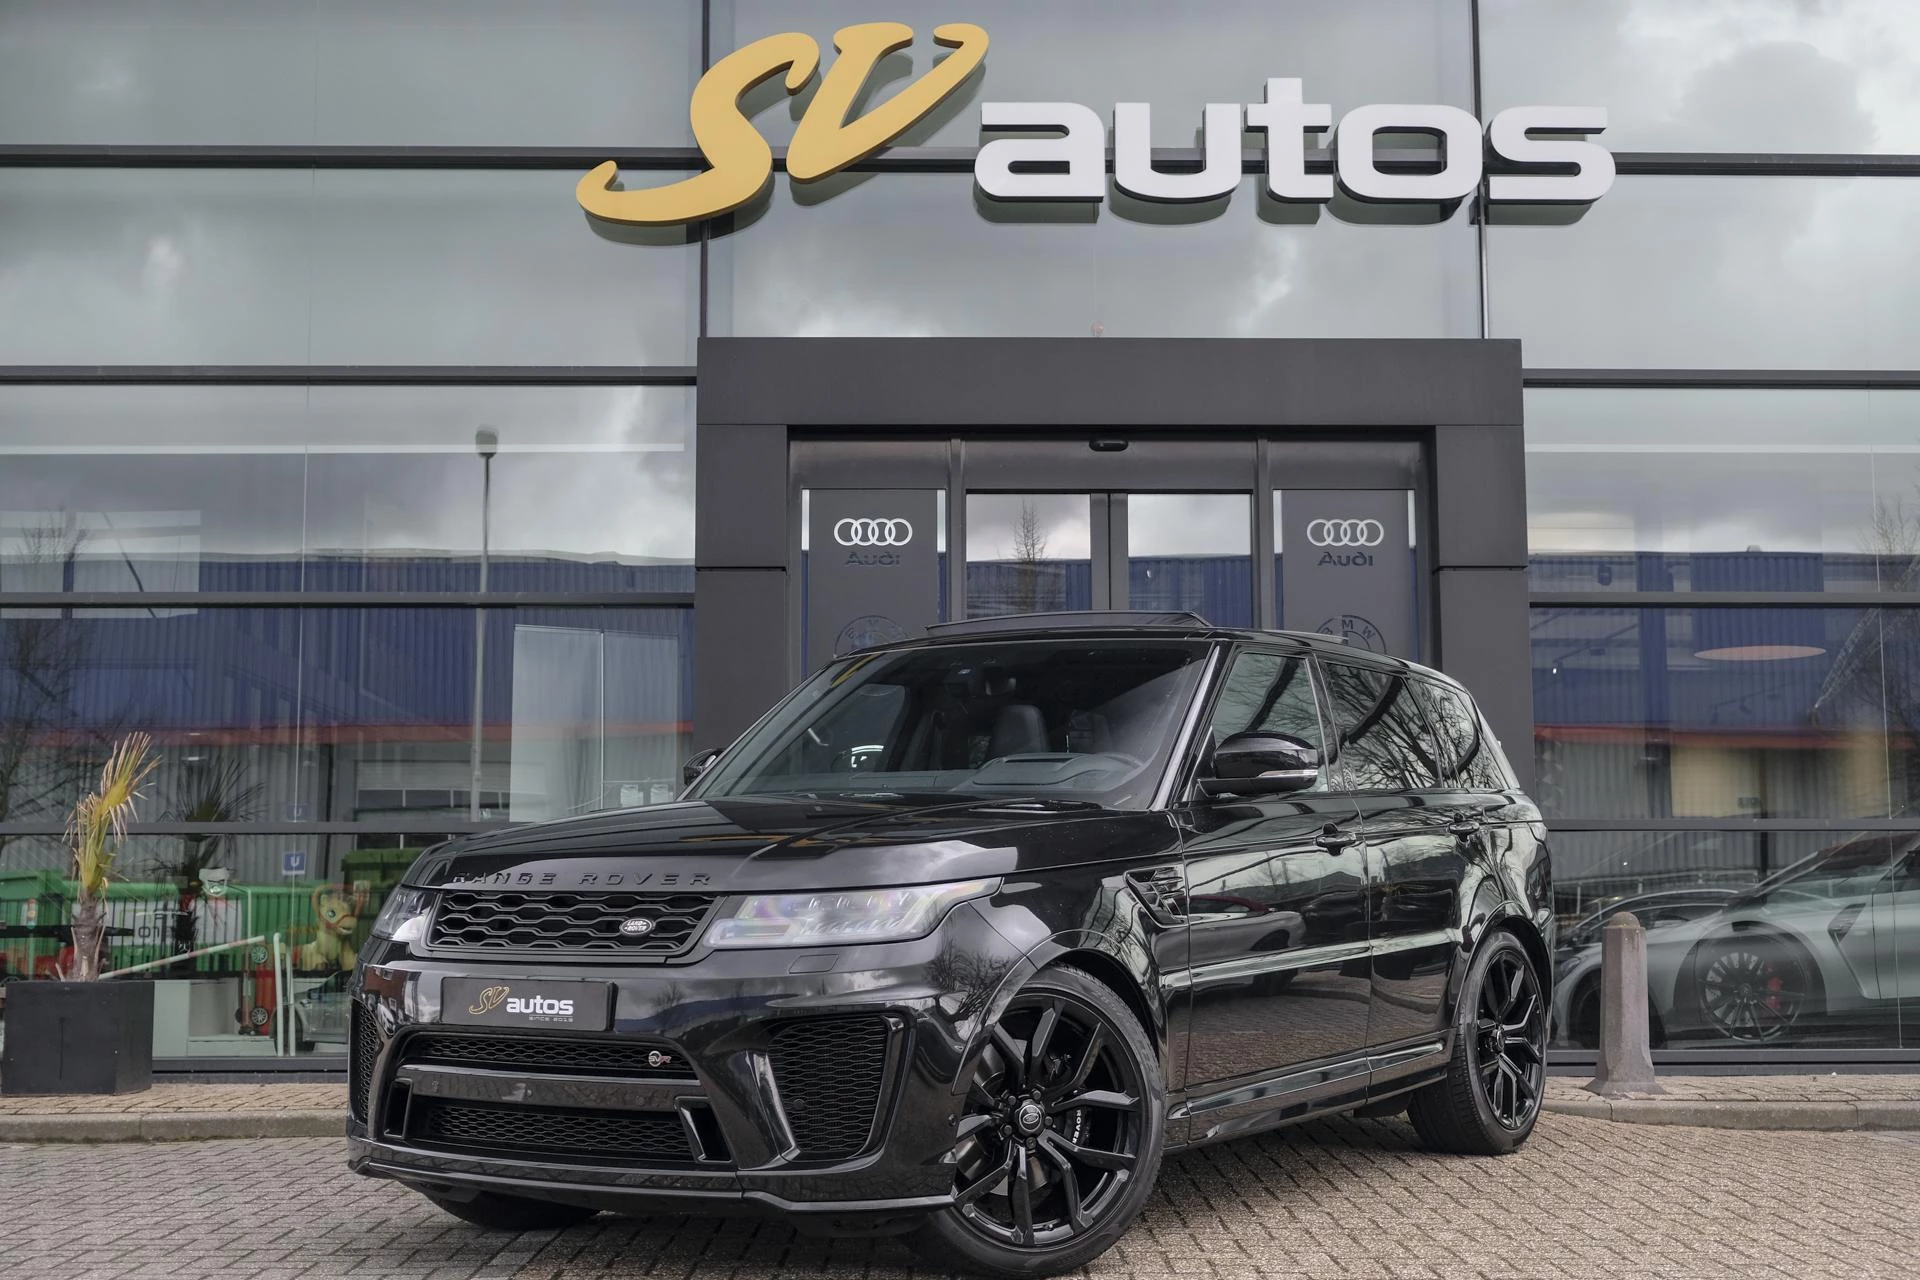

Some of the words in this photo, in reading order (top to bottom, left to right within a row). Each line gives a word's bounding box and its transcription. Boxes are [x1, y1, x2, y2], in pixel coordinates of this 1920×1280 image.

[575, 22, 990, 225] SV
[975, 78, 1618, 203] autos
[846, 551, 901, 567] Audi
[1317, 551, 1374, 567] Audi
[1320, 619, 1377, 640] BMW
[452, 872, 557, 885] RANGE
[579, 872, 711, 886] ROVER
[468, 986, 510, 1015] SV
[506, 995, 574, 1015] autos
